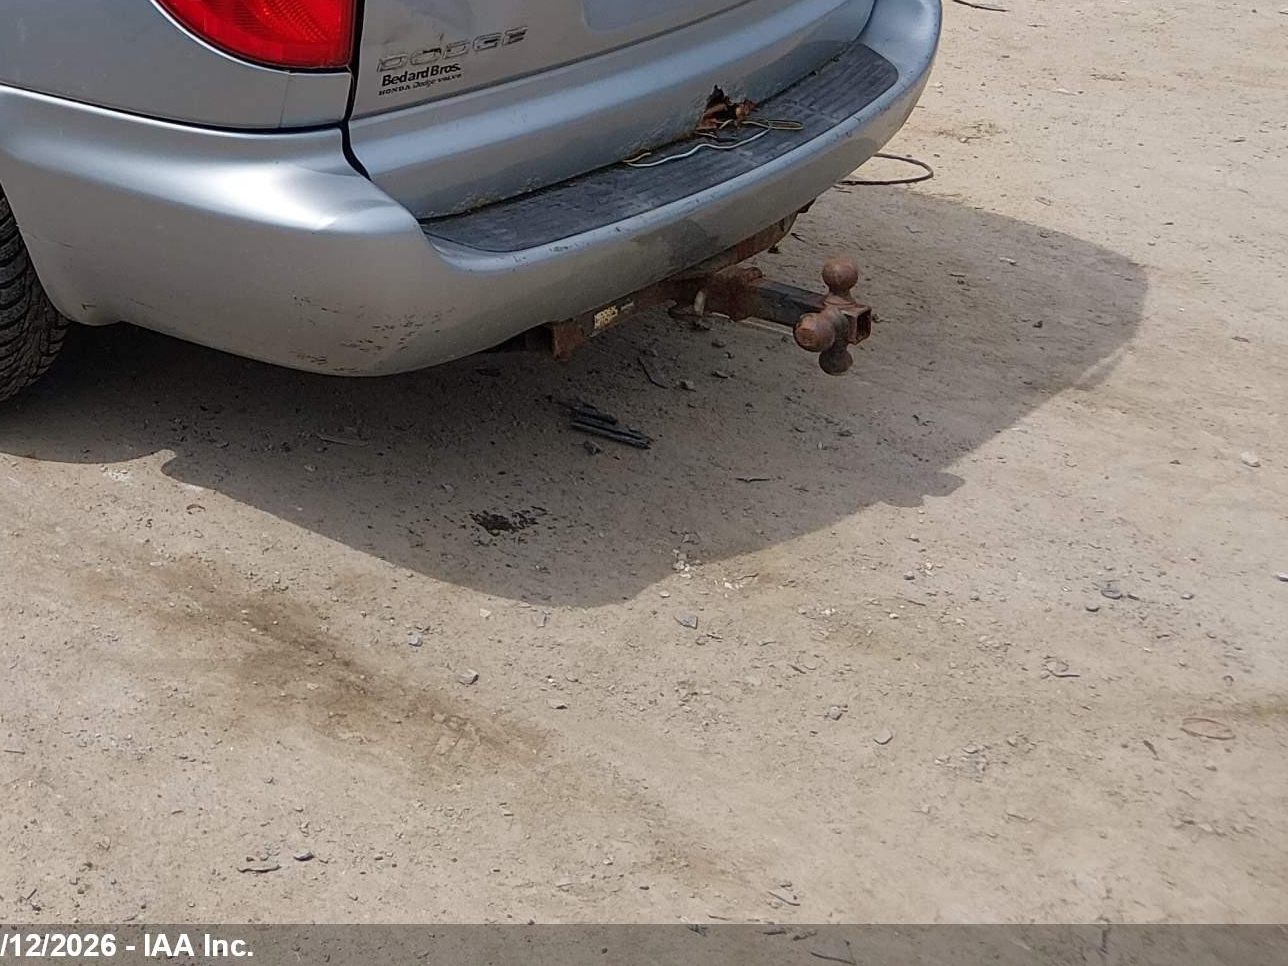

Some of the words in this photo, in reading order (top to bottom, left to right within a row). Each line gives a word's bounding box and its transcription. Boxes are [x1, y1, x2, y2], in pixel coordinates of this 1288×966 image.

[377, 26, 528, 72] DODGE
[381, 66, 429, 87] Bedard
[430, 63, 461, 76] Bros.
[378, 84, 411, 96] HONDA
